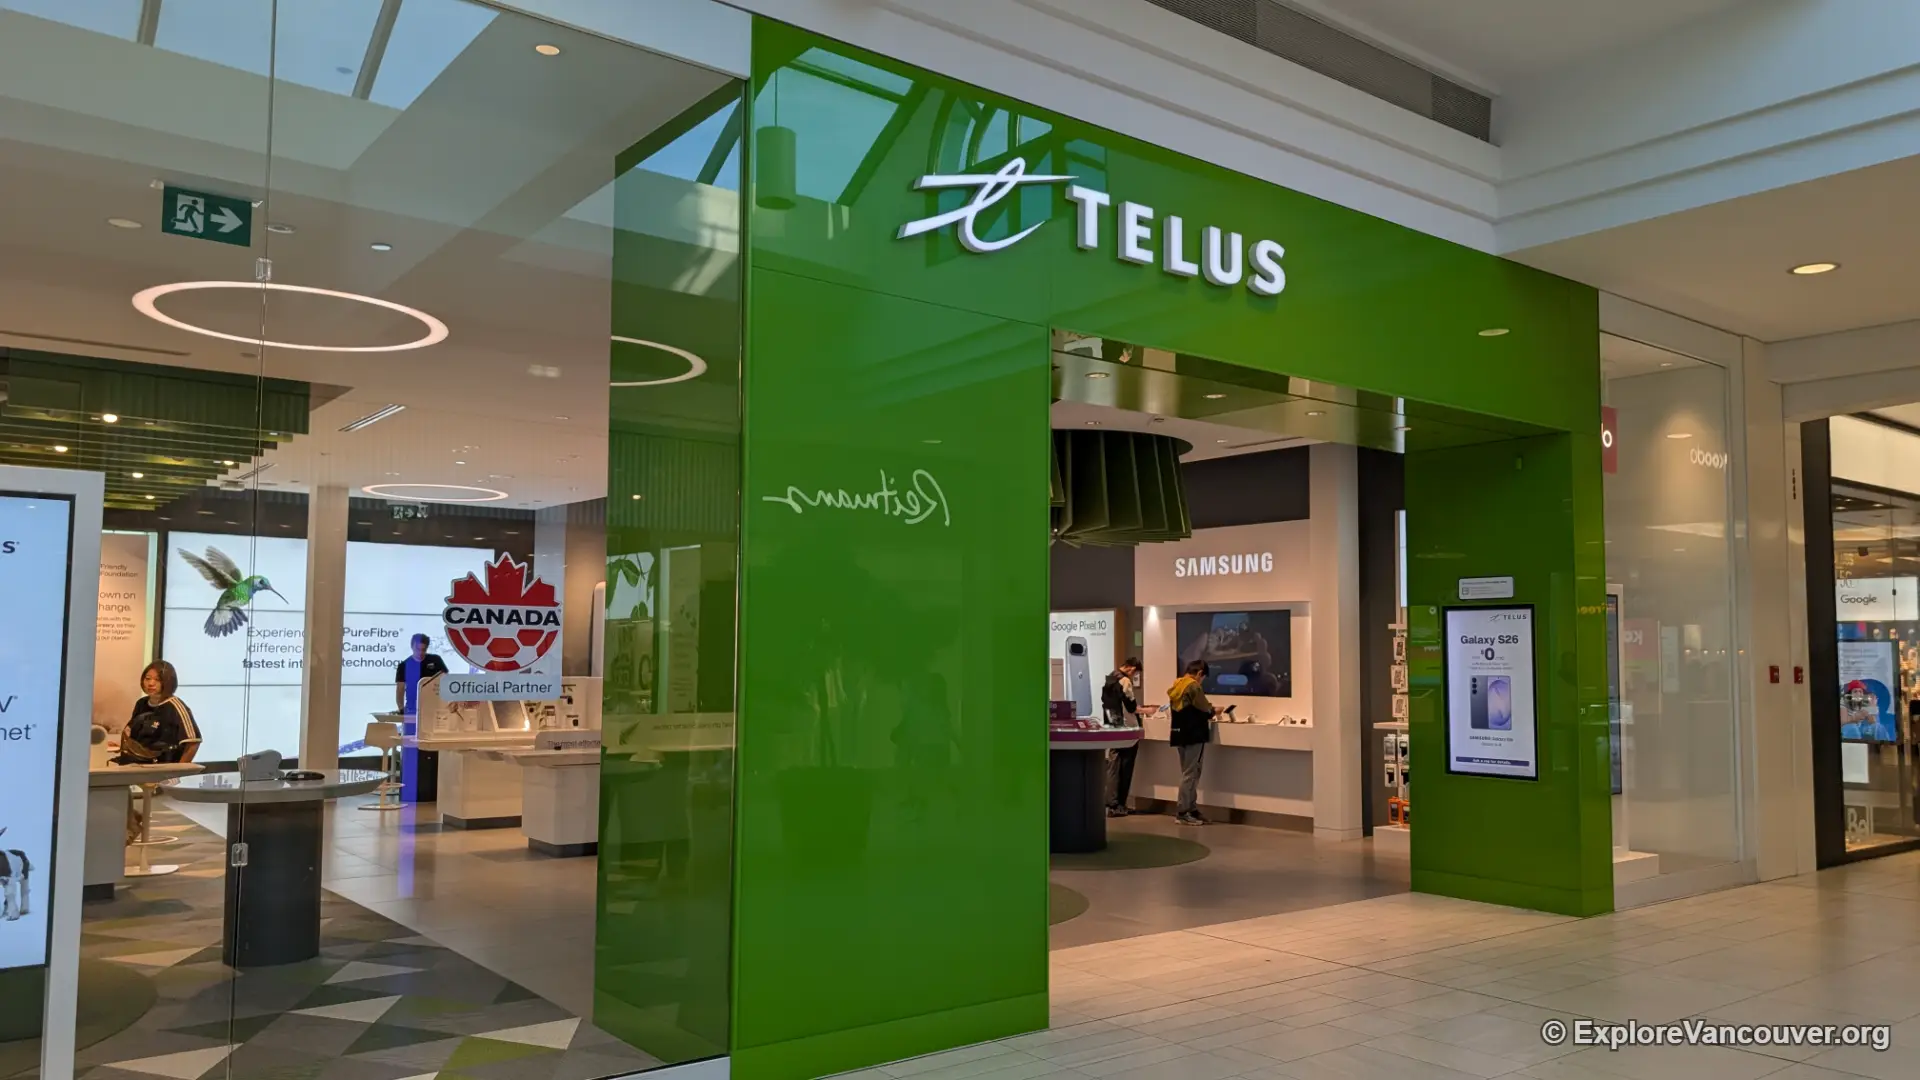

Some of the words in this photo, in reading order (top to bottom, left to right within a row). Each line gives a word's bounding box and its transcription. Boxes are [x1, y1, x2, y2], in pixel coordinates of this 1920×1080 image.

[1066, 184, 1287, 296] TELUS
[1175, 552, 1273, 578] SAMSUNG
[1840, 594, 1877, 606] Google
[445, 607, 560, 626] CANADA
[1051, 621, 1077, 633] Google
[1080, 620, 1096, 630] Pixel
[1097, 620, 1107, 630] 10
[1460, 635, 1495, 646] Galaxy
[1498, 634, 1519, 644] S26
[248, 643, 304, 653] differenc
[343, 642, 396, 653] Canada's
[242, 658, 286, 669] fastest
[342, 657, 404, 669] technolog
[449, 681, 499, 694] Official
[503, 681, 553, 693] Partner
